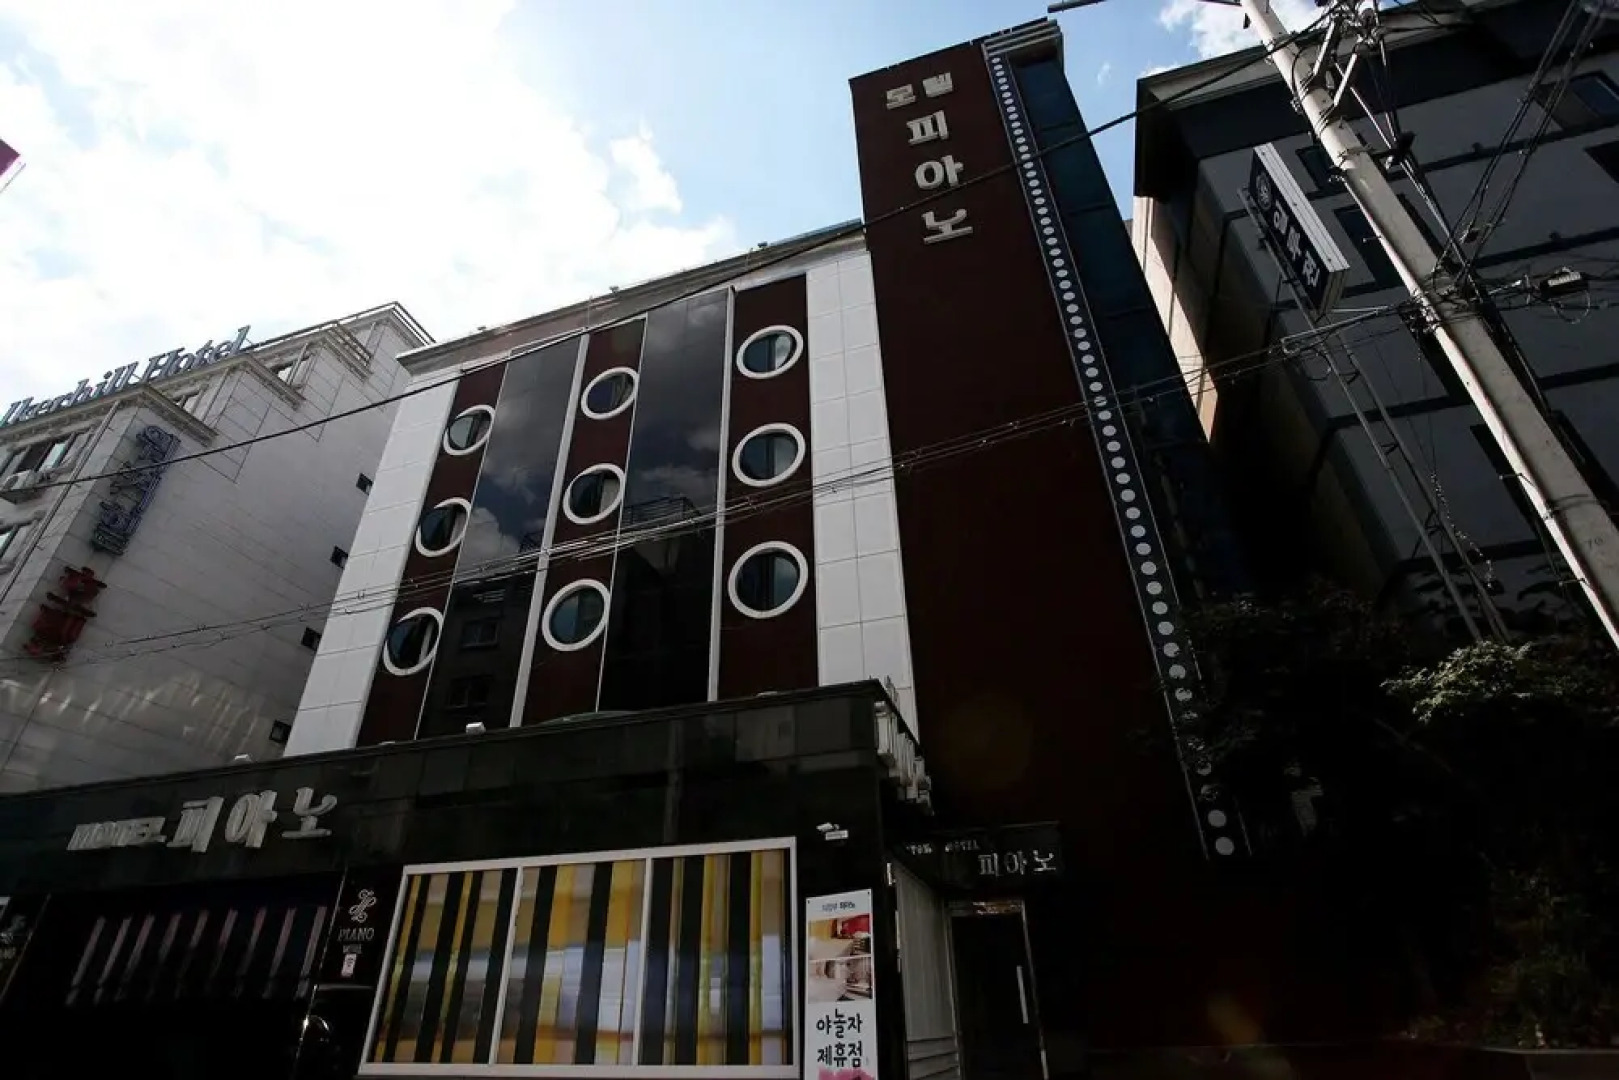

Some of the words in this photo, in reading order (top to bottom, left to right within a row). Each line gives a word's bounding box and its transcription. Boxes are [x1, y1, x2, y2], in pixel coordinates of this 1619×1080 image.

[906, 109, 974, 245] 피아노
[141, 325, 251, 382] Hotel
[165, 786, 338, 853] 피아노
[978, 850, 1057, 878] 피아노
[816, 1008, 863, 1038] 야놀자
[817, 1041, 862, 1068] 제휴점
